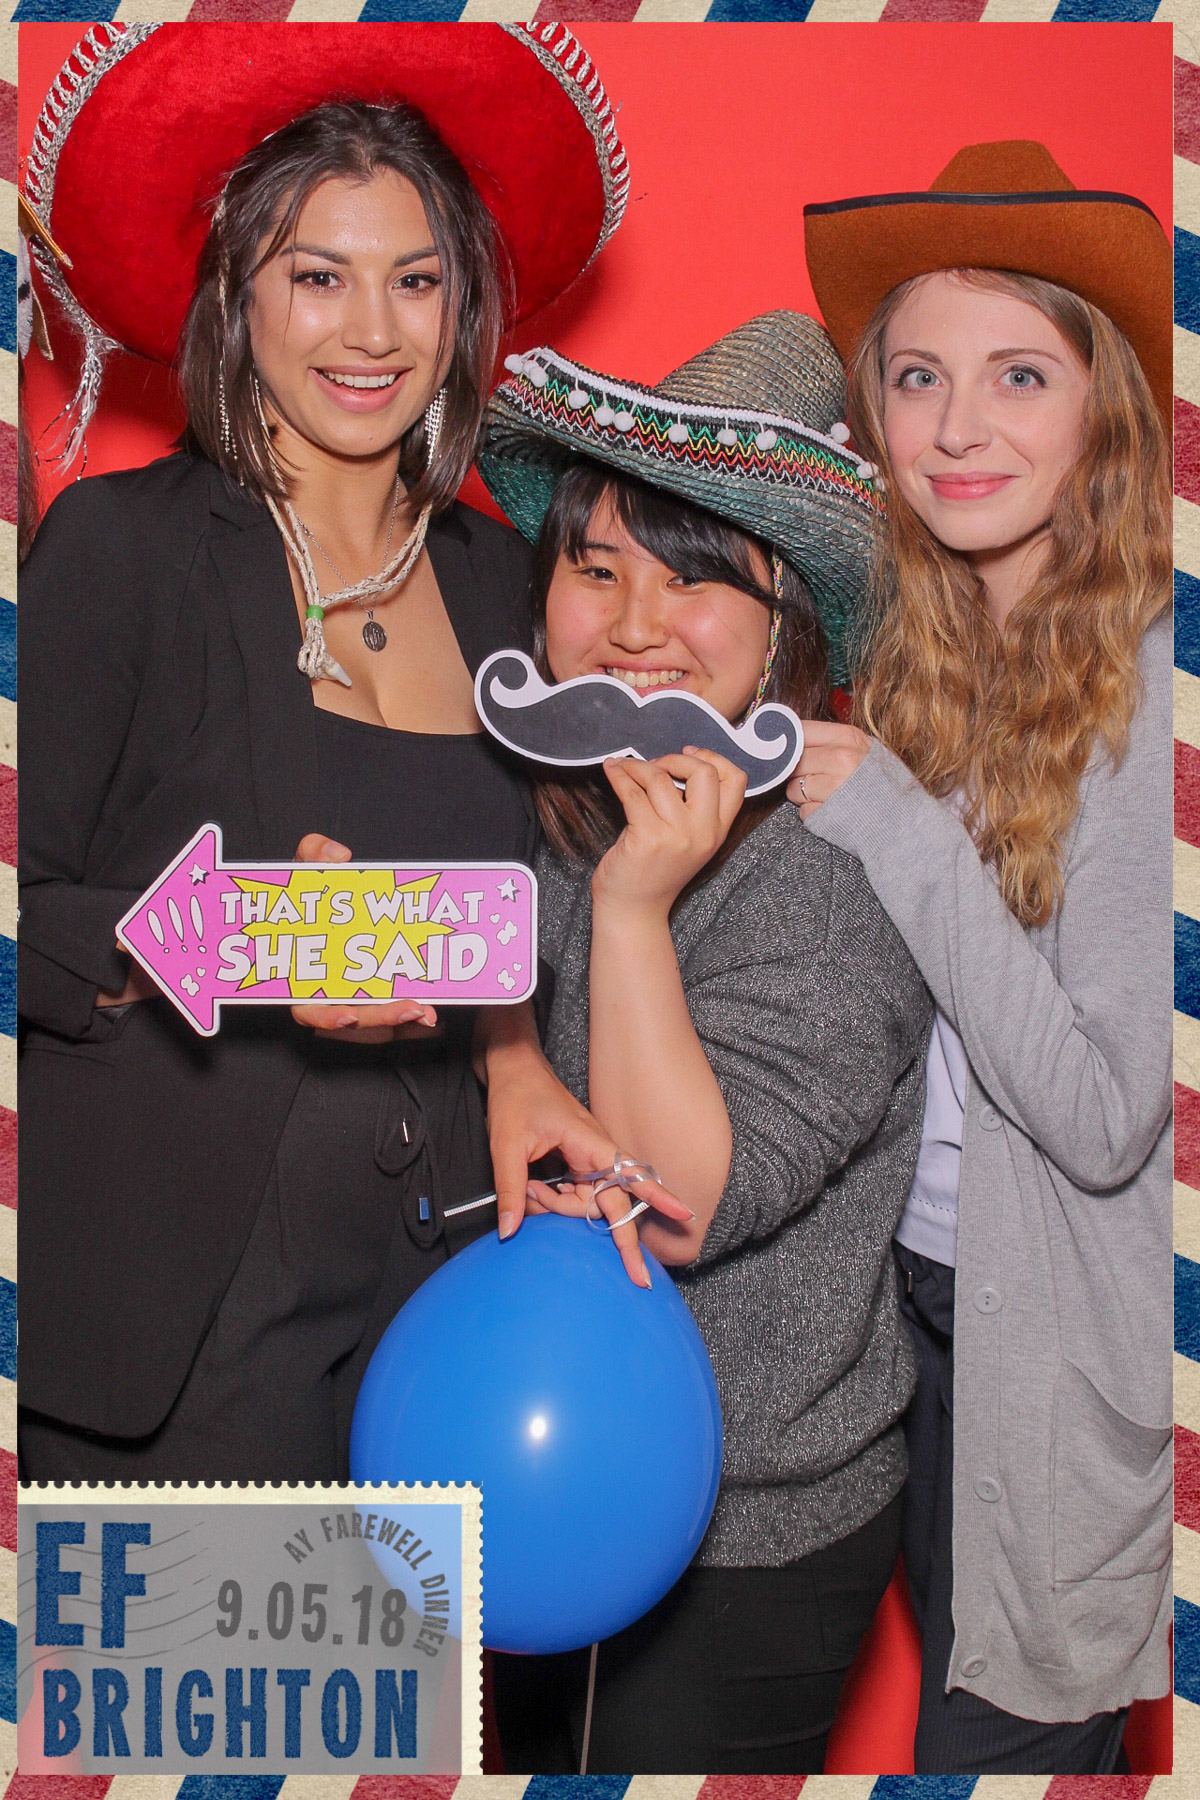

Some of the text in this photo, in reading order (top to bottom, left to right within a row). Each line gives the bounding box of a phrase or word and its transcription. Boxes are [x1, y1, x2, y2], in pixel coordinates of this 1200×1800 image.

[220, 886, 485, 926] THAT'S WHAT
[216, 931, 489, 984] SHE SAID
